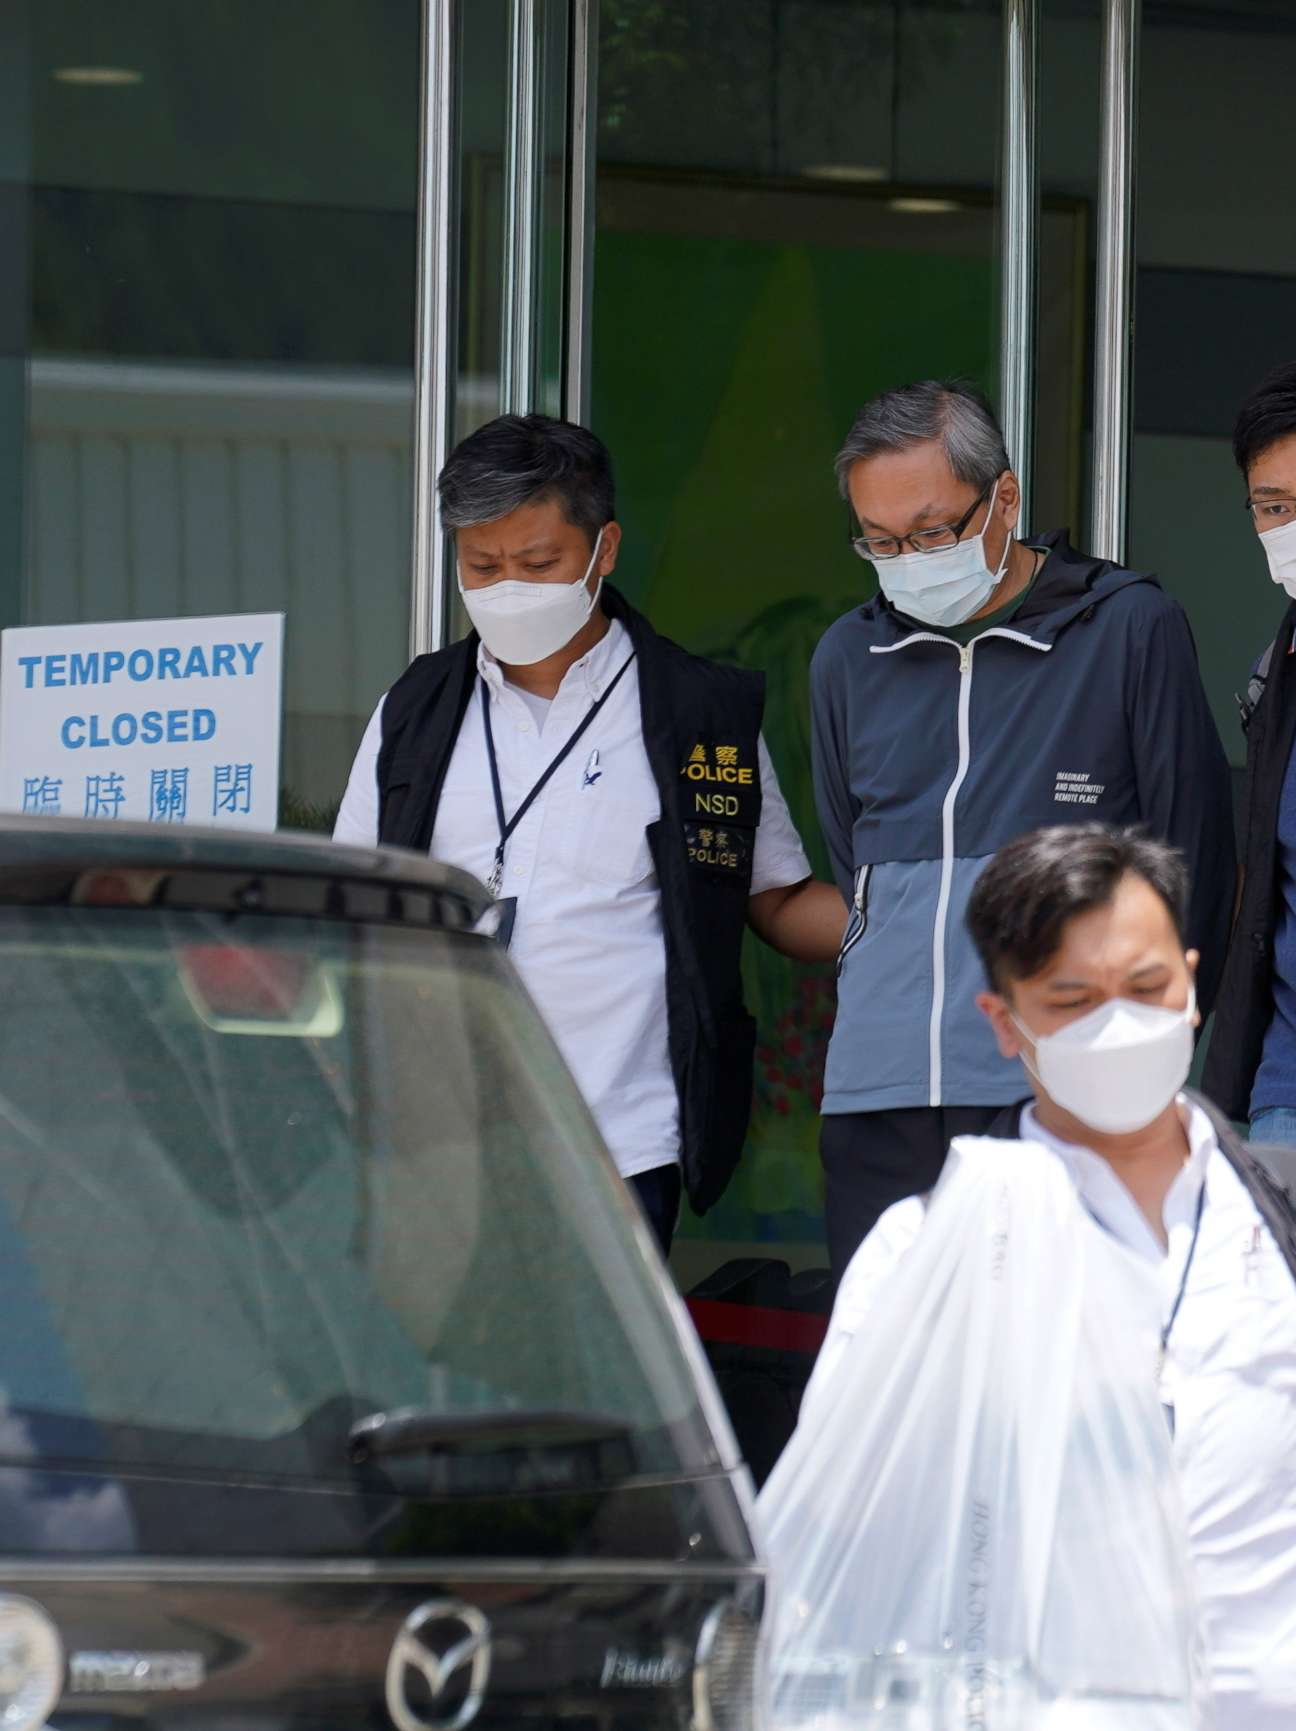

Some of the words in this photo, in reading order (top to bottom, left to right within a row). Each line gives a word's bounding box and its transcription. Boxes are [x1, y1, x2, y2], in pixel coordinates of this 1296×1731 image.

[18, 642, 264, 689] TEMPORARY
[61, 708, 217, 750] CLOSED
[22, 763, 254, 825] 臨時關閉
[680, 763, 753, 785] OLICE
[695, 793, 738, 816] NSD
[688, 848, 737, 867] POLICE
[968, 1501, 990, 1573] HONG
[966, 1583, 987, 1651] KONG
